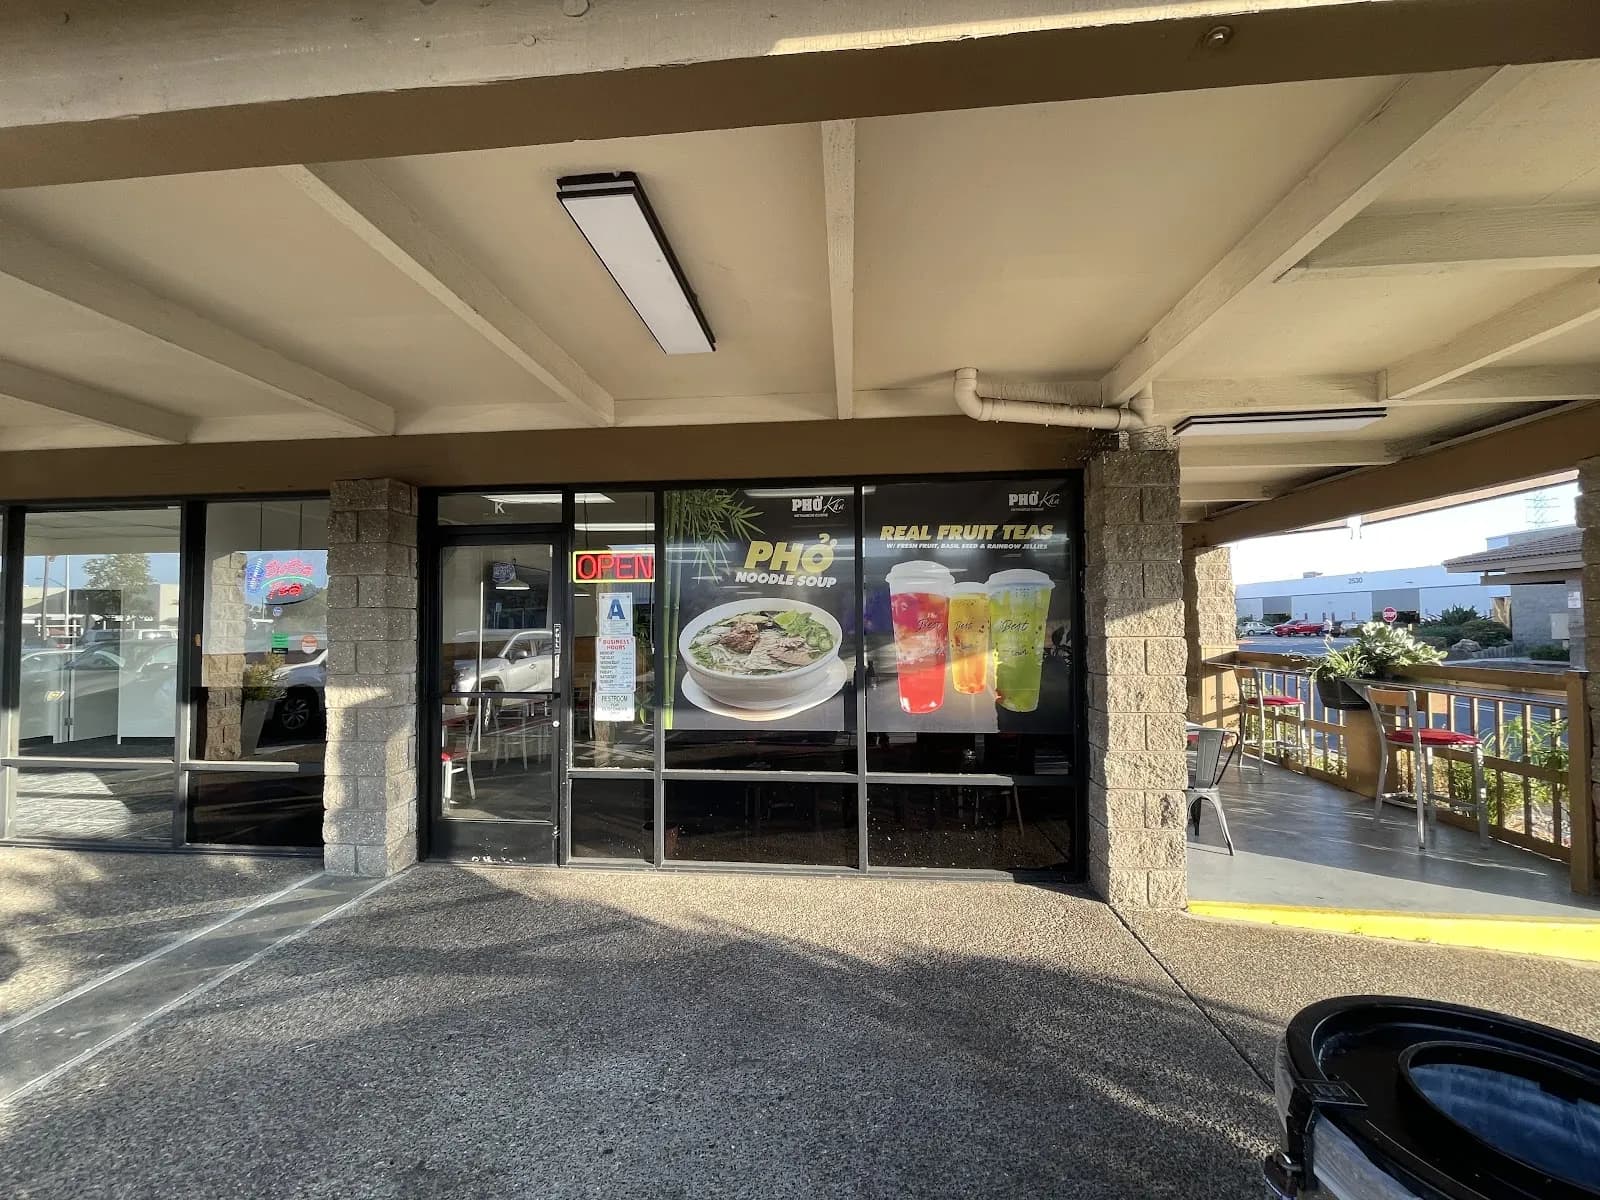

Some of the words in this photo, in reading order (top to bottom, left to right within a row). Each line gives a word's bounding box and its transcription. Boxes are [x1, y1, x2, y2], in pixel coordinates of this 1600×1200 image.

[495, 502, 504, 514] K
[880, 525, 932, 540] REAL
[937, 525, 999, 540] FRUIT
[1003, 525, 1054, 540] TEAS
[577, 554, 653, 580] OPEN
[735, 571, 796, 586] NOODLE
[797, 575, 837, 588] SOUP
[607, 599, 625, 620] A
